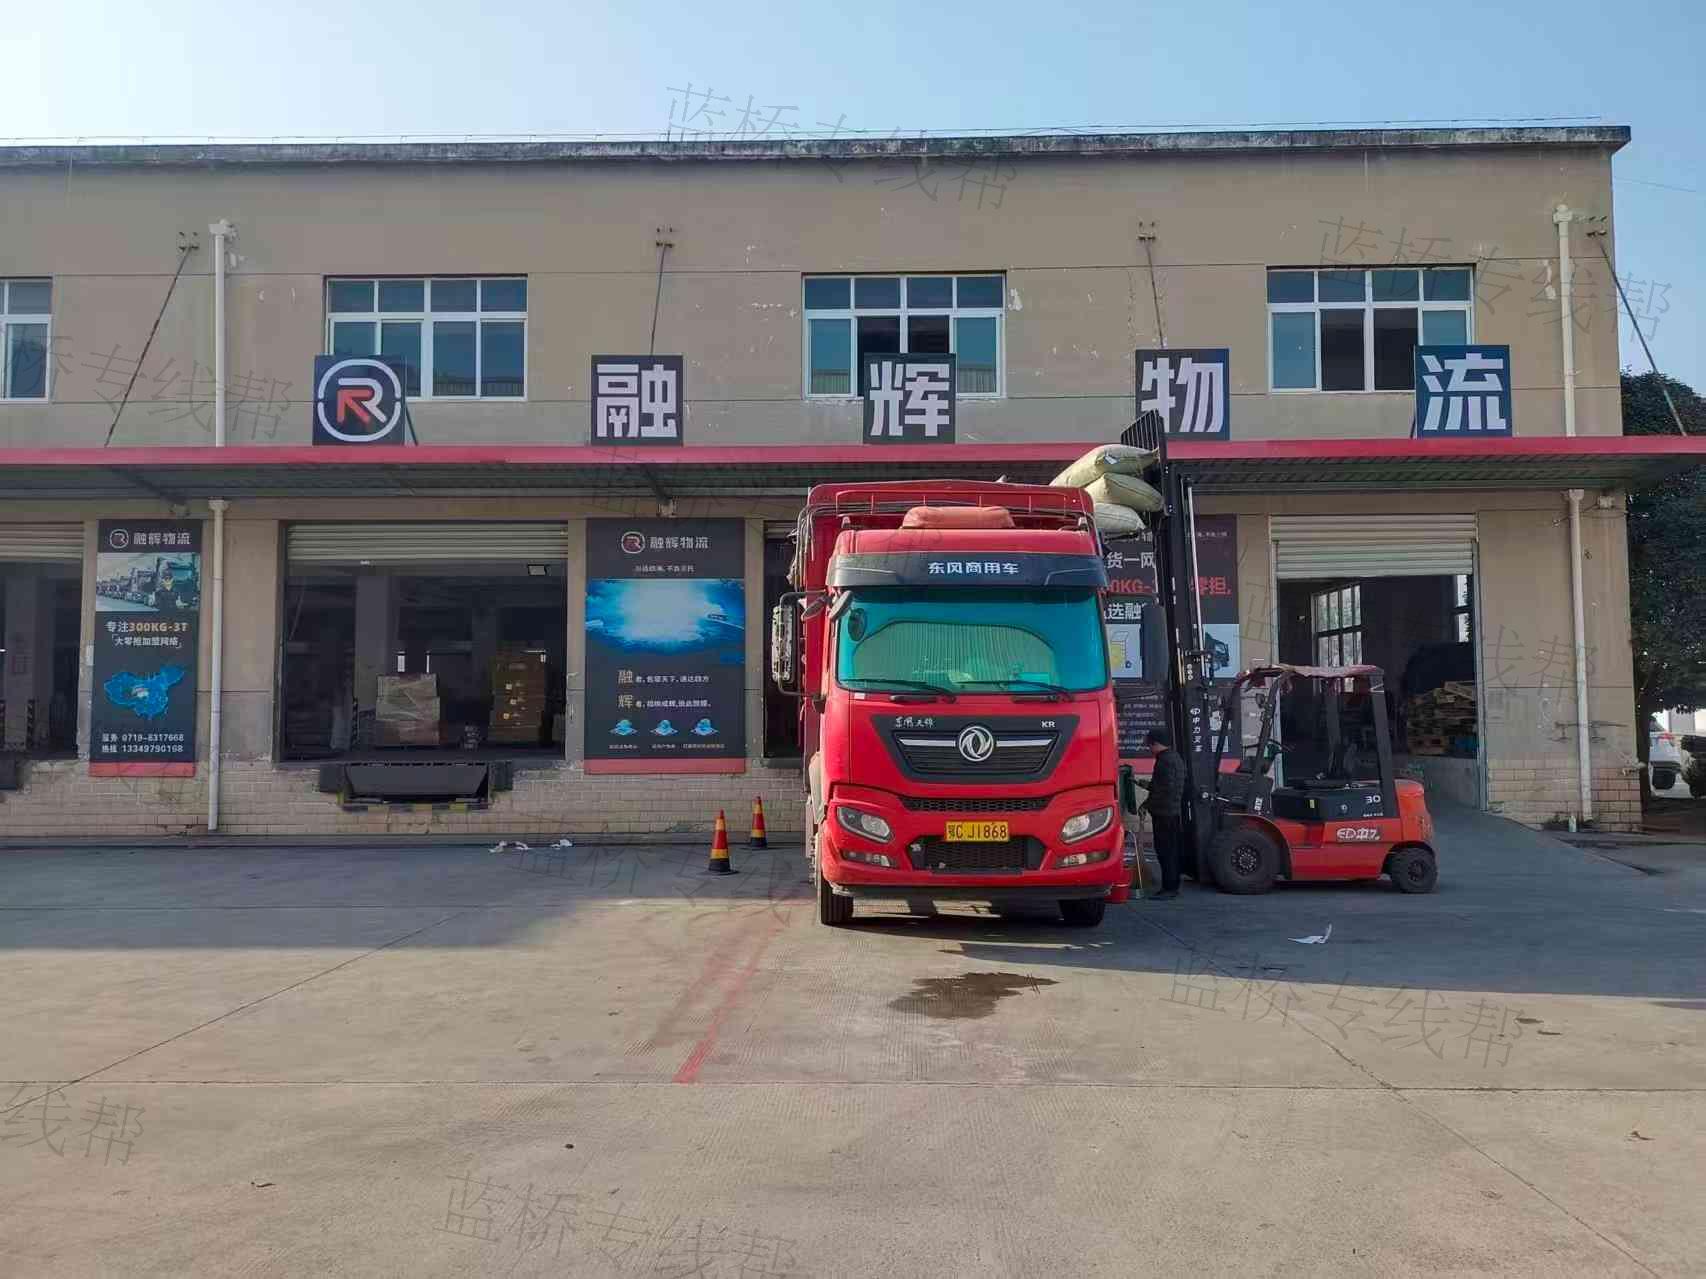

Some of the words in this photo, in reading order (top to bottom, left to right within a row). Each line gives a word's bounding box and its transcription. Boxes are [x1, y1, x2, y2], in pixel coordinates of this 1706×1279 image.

[597, 364, 676, 437] 融
[870, 362, 950, 436] 辉
[1141, 356, 1224, 432] 物
[1424, 352, 1507, 431] 流
[649, 536, 709, 549] 融辉物流
[928, 561, 1019, 575] 东风商用车
[1041, 720, 1056, 728] KR
